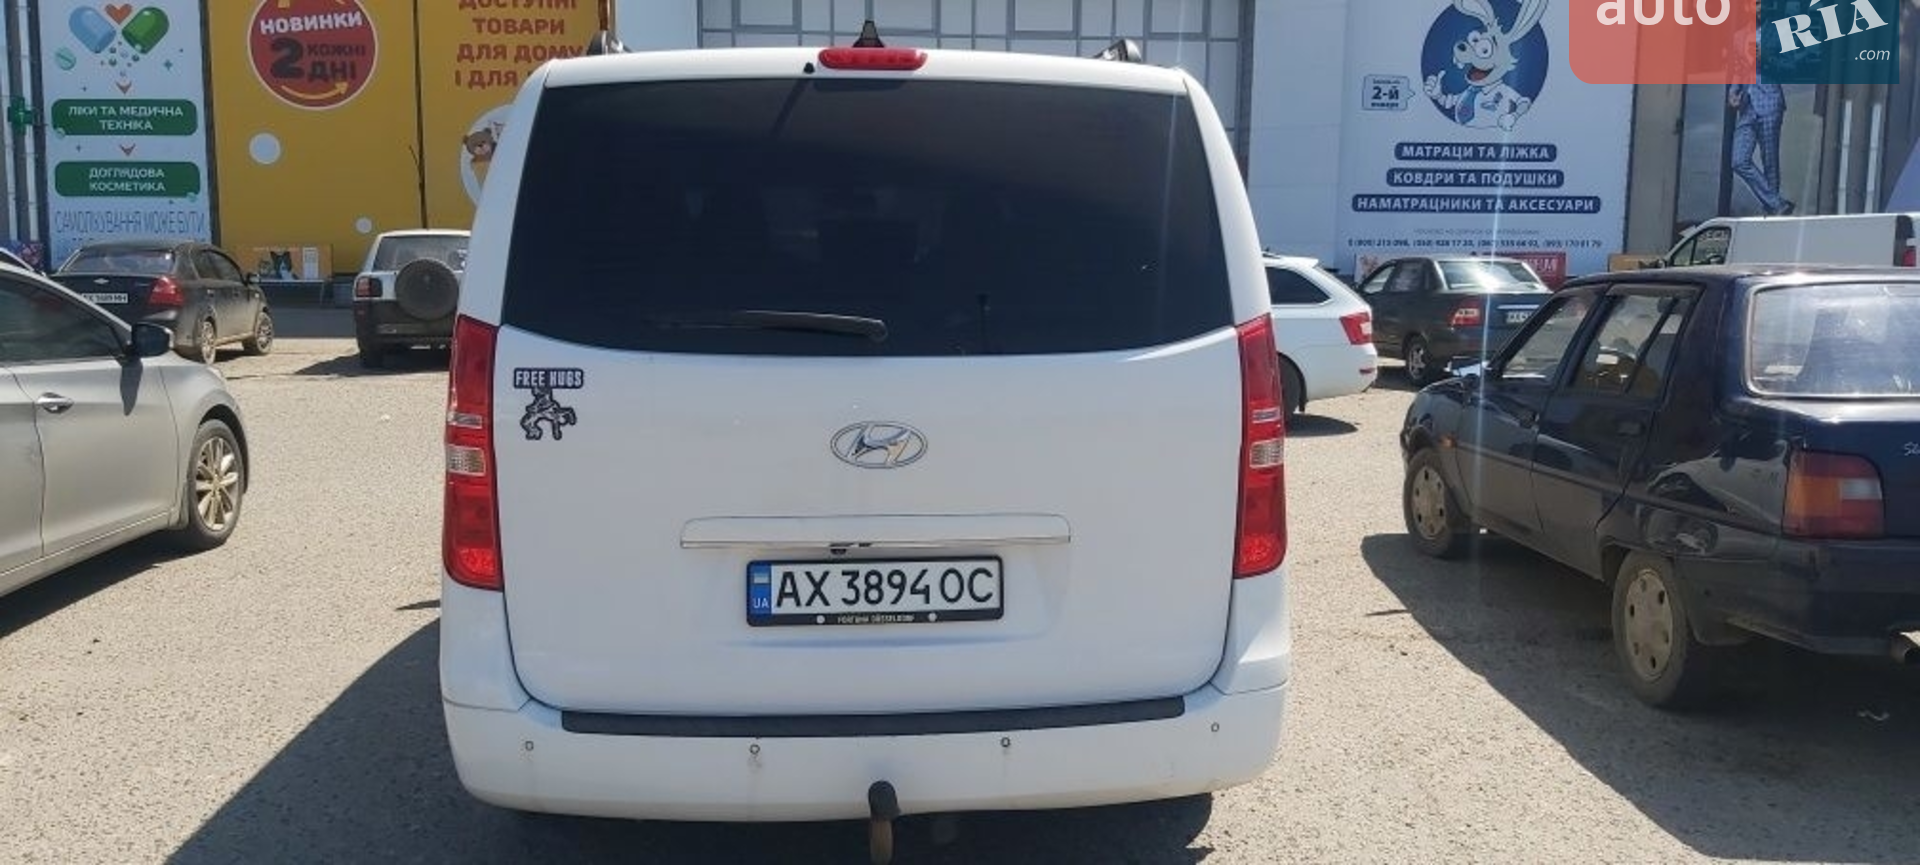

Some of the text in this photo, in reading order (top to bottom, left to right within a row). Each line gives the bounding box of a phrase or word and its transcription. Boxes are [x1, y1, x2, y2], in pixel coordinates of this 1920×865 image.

[260, 11, 363, 35] НОВИНКИ
[472, 18, 565, 35] ТОВАРИ
[270, 37, 366, 79] 2 КОЖНІ
[457, 43, 584, 63] ДЛЯ ДОМУ
[308, 61, 356, 82] ДНІ
[468, 70, 519, 90] ДЛЯ
[68, 106, 184, 118] ЛІКИ ТА МЕДИЧНА
[99, 120, 153, 131] ТЕХНІКА
[1401, 146, 1550, 160] МАТРАЦИ ТА ЛІЖКА
[88, 168, 165, 180] ДОГЛЯДОВА
[1393, 172, 1558, 187] КОВДРИ ТА ПОДУШКИ
[89, 182, 166, 192] КОСМЕТИКА
[1357, 197, 1594, 212] НАМАТРАЦНИКИ ТА АКСЕСУАРИ
[515, 370, 582, 387] FREE HUGS
[776, 567, 993, 608] AX 3894 OC
[753, 597, 770, 609] UA
